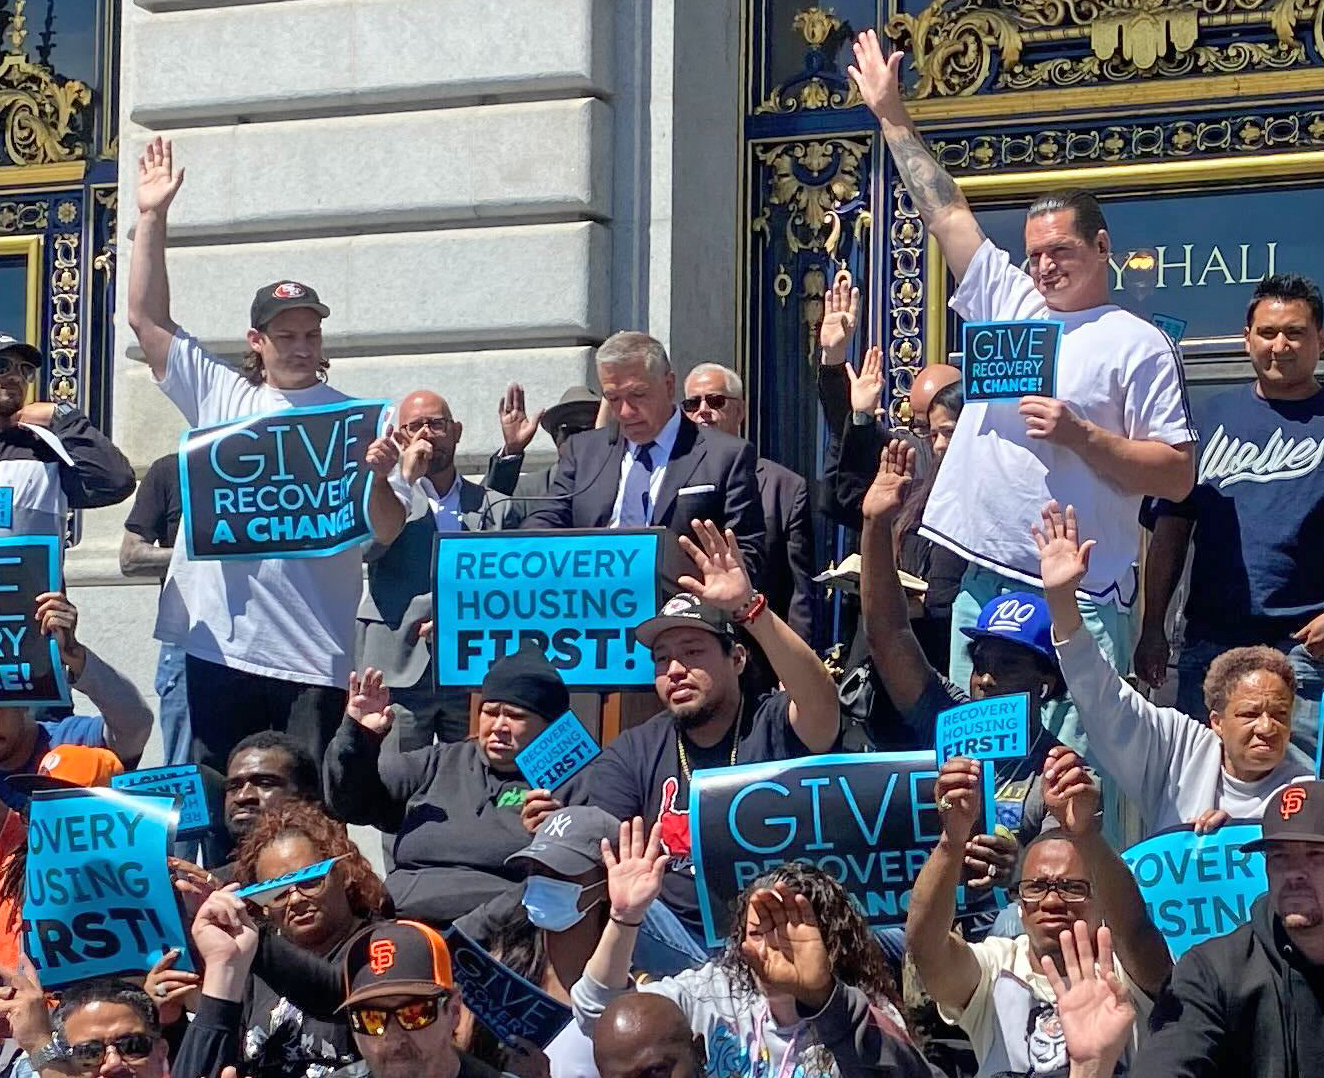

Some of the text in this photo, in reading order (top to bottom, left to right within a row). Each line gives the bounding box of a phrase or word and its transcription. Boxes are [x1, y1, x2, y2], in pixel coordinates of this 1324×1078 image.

[1155, 242, 1278, 289] HALL
[973, 327, 1047, 360] GIVE
[970, 376, 1043, 394] A CHANCE!
[972, 360, 1044, 377] RECOVERY
[210, 413, 364, 483] GIVE
[214, 471, 358, 514] RECOVERY
[211, 501, 356, 544] A CHANCE!
[454, 548, 640, 580] RECOVERY
[456, 588, 638, 620] HOUSING
[988, 599, 1037, 626] 100
[942, 718, 1018, 743] HOUSING
[943, 702, 1018, 727] RECOVERY
[522, 718, 573, 765] RECOVERY
[528, 730, 582, 778] HOUSING
[942, 732, 1018, 763] FIRST!
[536, 741, 592, 790] FIRST!
[29, 811, 146, 855] OVERY
[728, 771, 939, 855] GIVE
[28, 861, 150, 907] USING
[455, 948, 557, 1030] GIVE
